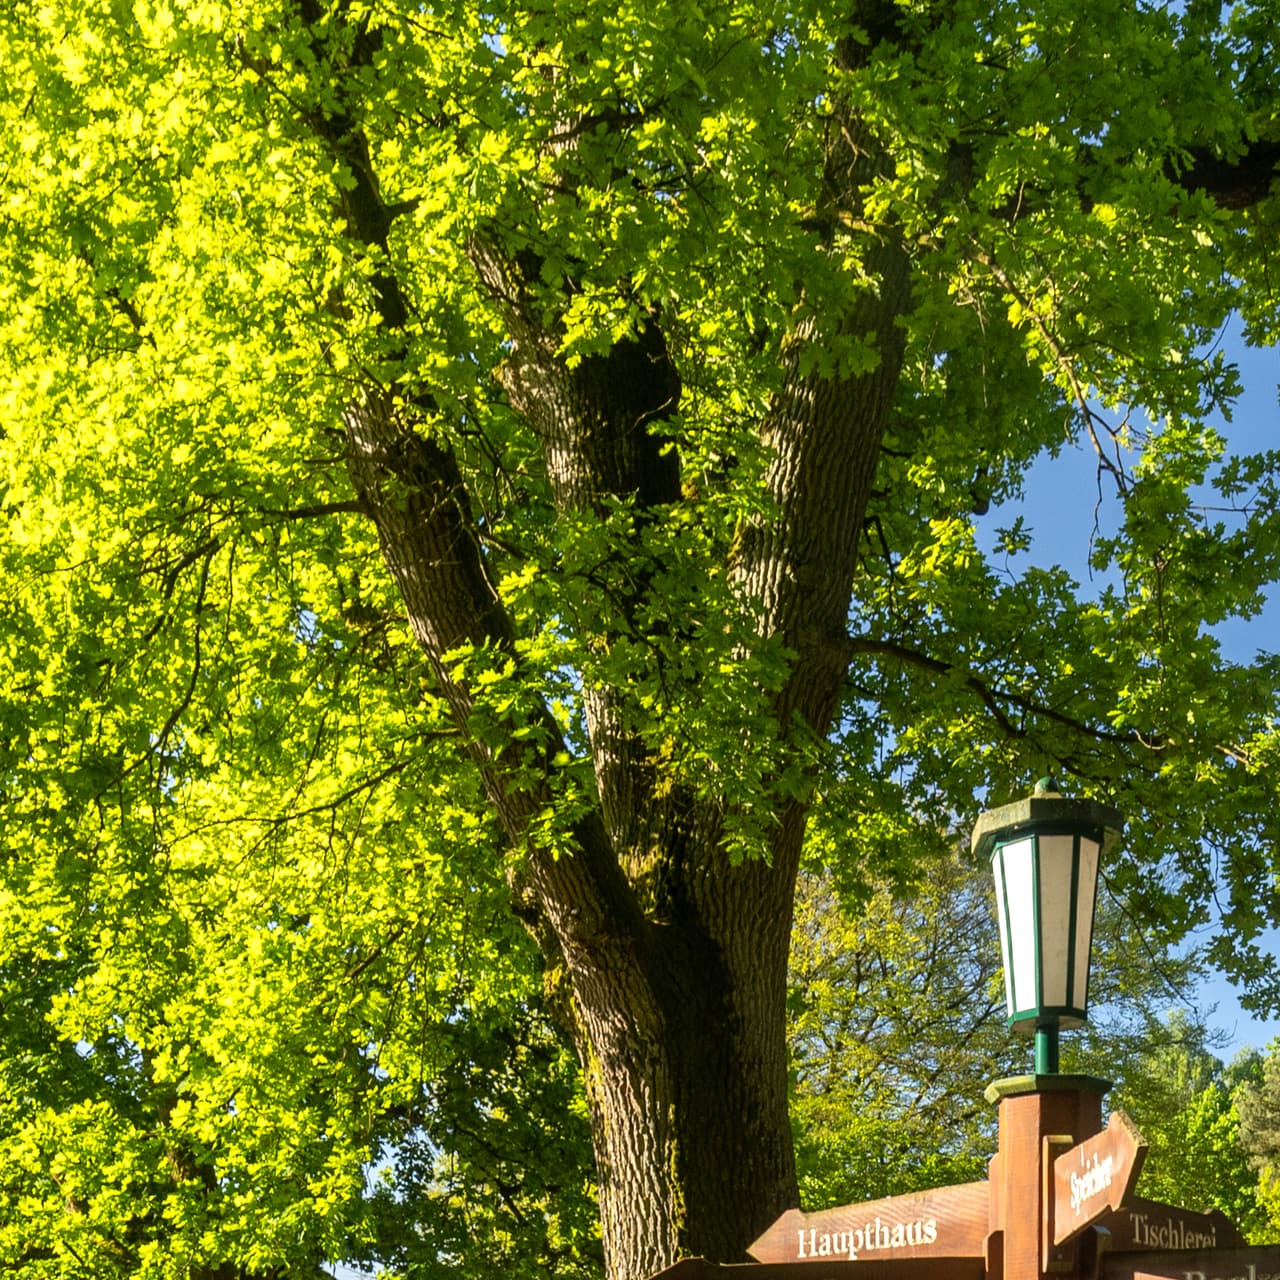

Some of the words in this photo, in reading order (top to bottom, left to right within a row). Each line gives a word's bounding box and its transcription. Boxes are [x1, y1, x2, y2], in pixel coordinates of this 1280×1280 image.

[1071, 1153, 1113, 1216] Speicher
[797, 1217, 938, 1260] Haupthaus
[1130, 1213, 1217, 1250] Tischlerei
